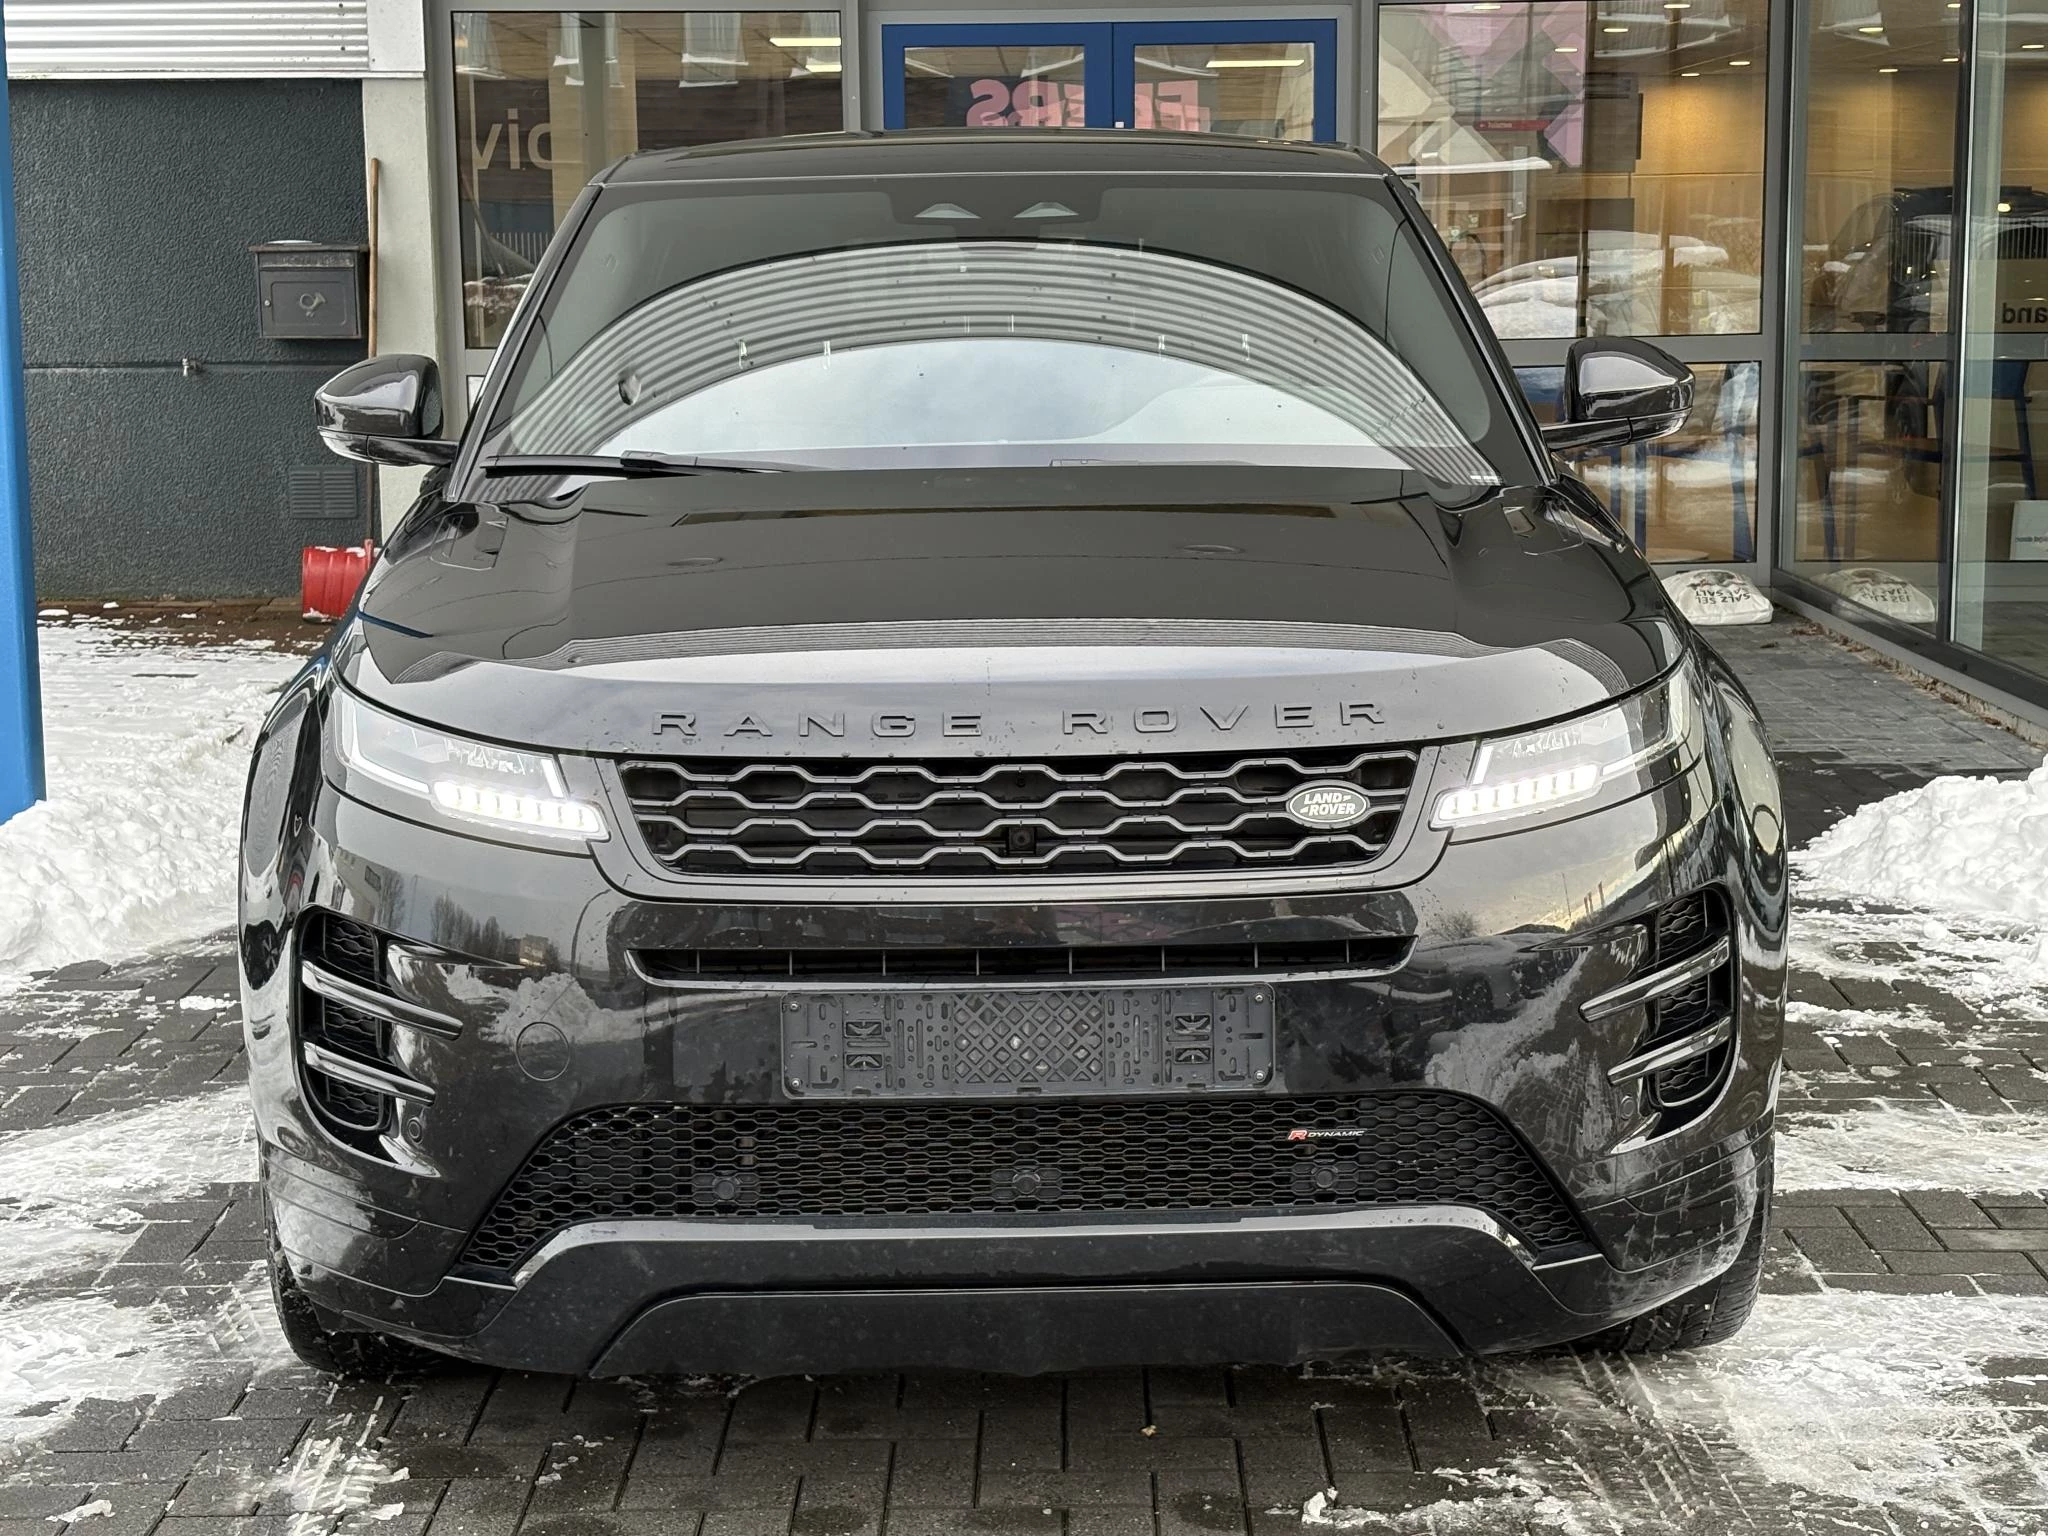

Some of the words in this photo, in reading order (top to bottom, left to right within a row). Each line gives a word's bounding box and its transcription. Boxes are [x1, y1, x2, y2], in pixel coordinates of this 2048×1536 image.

[1720, 593, 1751, 603] SALZ
[652, 711, 983, 738] RANGE
[1062, 701, 1385, 735] ROVER
[1304, 793, 1342, 804] LAND
[1309, 803, 1356, 816] ROVER
